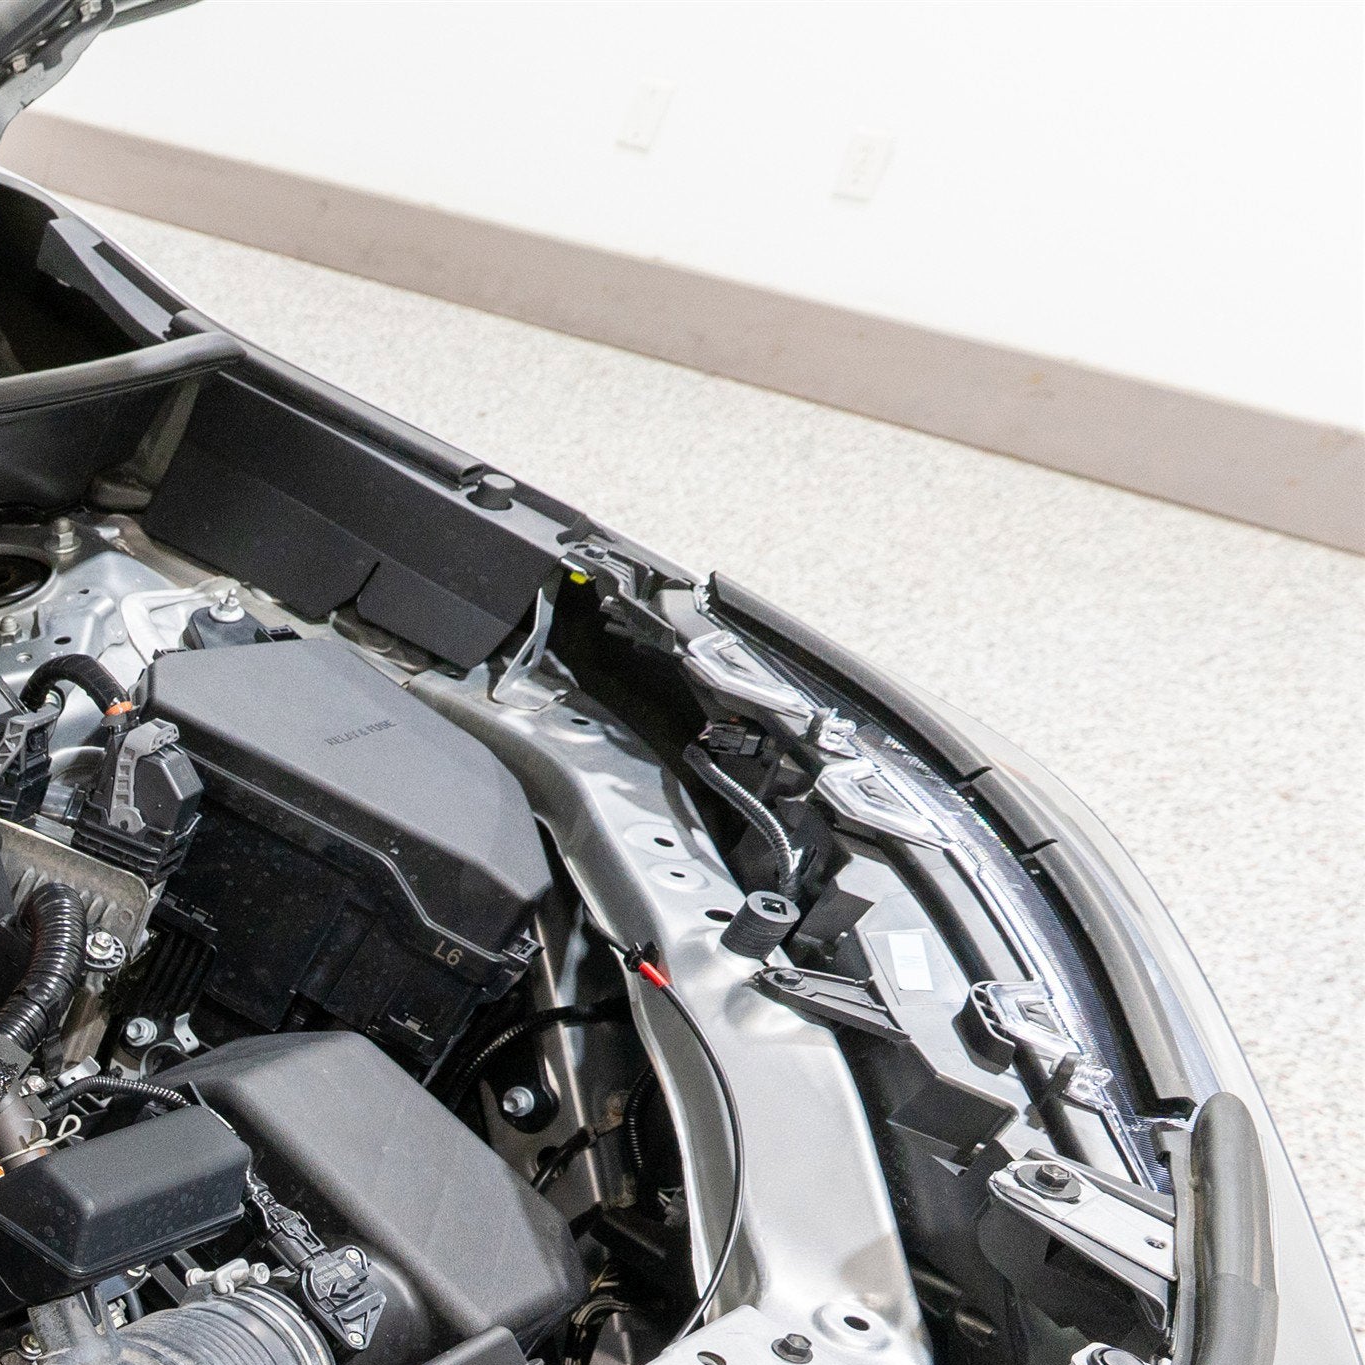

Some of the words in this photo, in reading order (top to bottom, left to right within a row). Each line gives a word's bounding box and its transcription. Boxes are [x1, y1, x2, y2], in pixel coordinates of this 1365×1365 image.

[324, 726, 359, 747] RELAY
[367, 718, 397, 734] FUSE
[433, 940, 463, 966] L6
